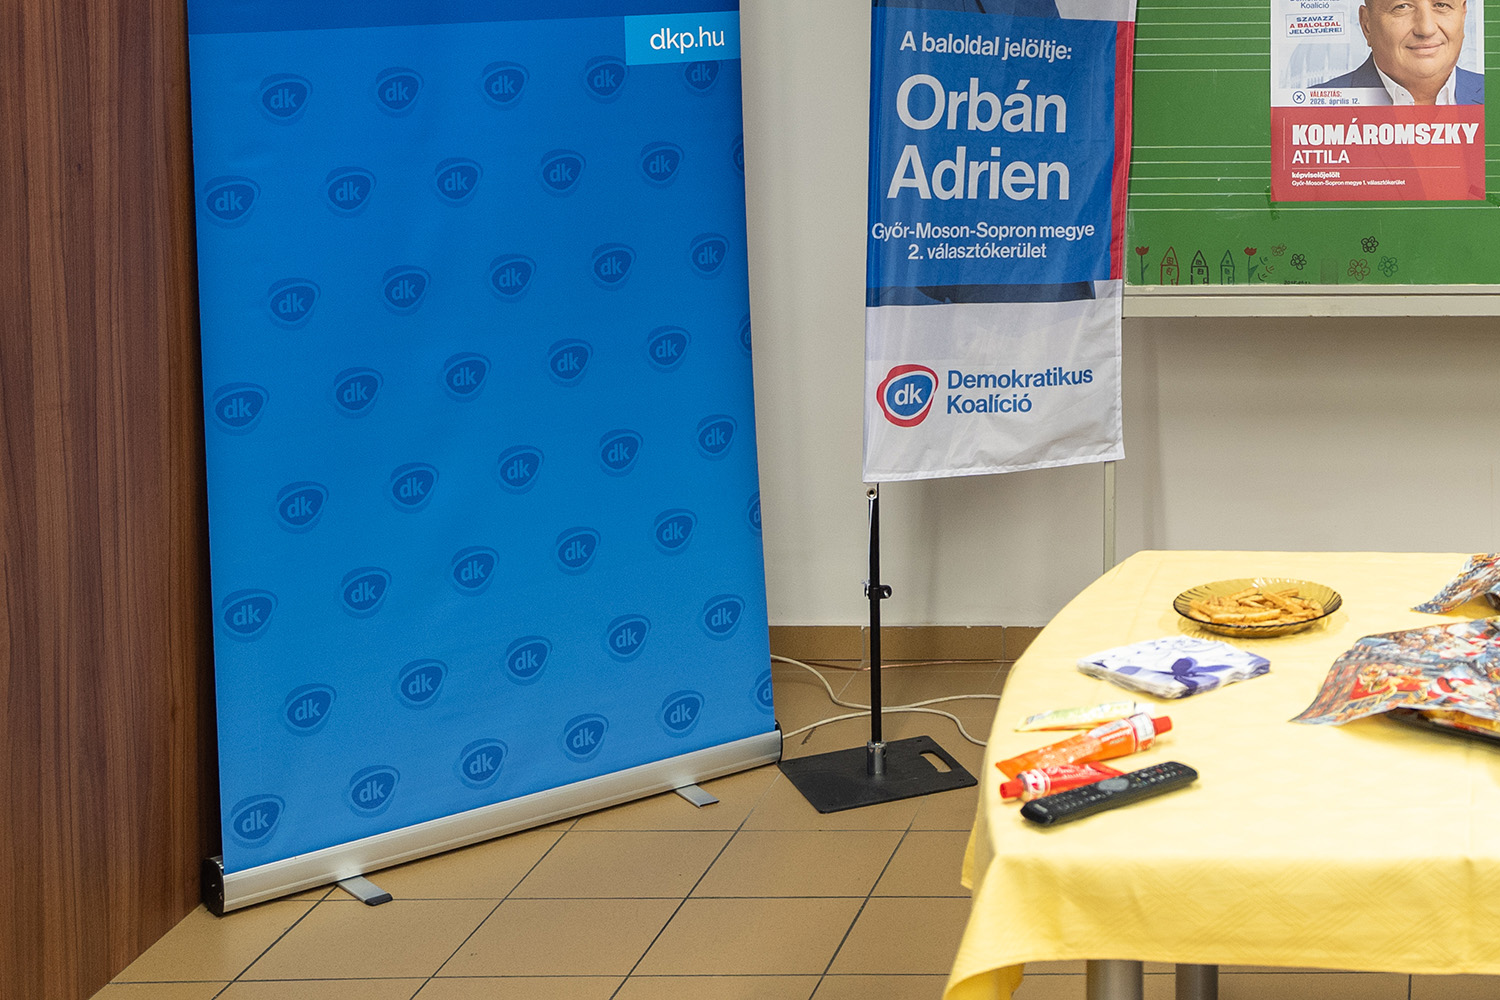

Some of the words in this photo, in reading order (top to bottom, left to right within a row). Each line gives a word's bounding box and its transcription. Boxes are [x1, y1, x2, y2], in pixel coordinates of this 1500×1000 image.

[649, 27, 725, 54] dkp.hu
[900, 31, 916, 51] A
[922, 33, 999, 56] baloldal
[1002, 38, 1072, 62] jelöltje:
[385, 82, 409, 101] dk
[492, 76, 515, 94] dk
[1310, 90, 1342, 98] VÁLASZTÁS:
[270, 89, 296, 109] dk
[896, 74, 1067, 133] Orbán
[1292, 118, 1479, 145] KOMÁROMSZKY
[1292, 149, 1350, 164] ATTILA
[444, 172, 468, 191] dk
[550, 163, 572, 182] dk
[887, 145, 1069, 200] Adrien
[215, 191, 243, 211] dk
[336, 181, 360, 201] dk
[871, 222, 1036, 242] Győr-Moson-Sopron
[1040, 224, 1095, 241] megye
[908, 244, 923, 259] 2.
[927, 243, 1047, 259] választókerület
[601, 257, 622, 275] dk
[499, 268, 522, 287] dk
[392, 280, 415, 300] dk
[279, 293, 304, 313] dk
[557, 353, 579, 372] dk
[453, 367, 476, 386] dk
[948, 367, 1093, 389] Demokratikus
[344, 382, 368, 402] dk
[894, 383, 923, 406] dk
[224, 398, 252, 418] dk
[947, 393, 1032, 414] Koalíció
[608, 443, 629, 462] dk
[507, 460, 529, 479] dk
[400, 477, 424, 498] dk
[287, 496, 312, 518] dk
[565, 541, 587, 560] dk
[461, 561, 485, 581] dk
[351, 582, 376, 603] dk
[233, 604, 261, 626] dk
[616, 628, 637, 648] dk
[515, 650, 538, 670] dk
[408, 674, 432, 694] dk
[295, 699, 320, 721] dk
[671, 704, 691, 723] dk
[573, 728, 595, 748] dk
[470, 753, 493, 774] dk
[359, 781, 384, 802] dk
[242, 810, 268, 832] dk
